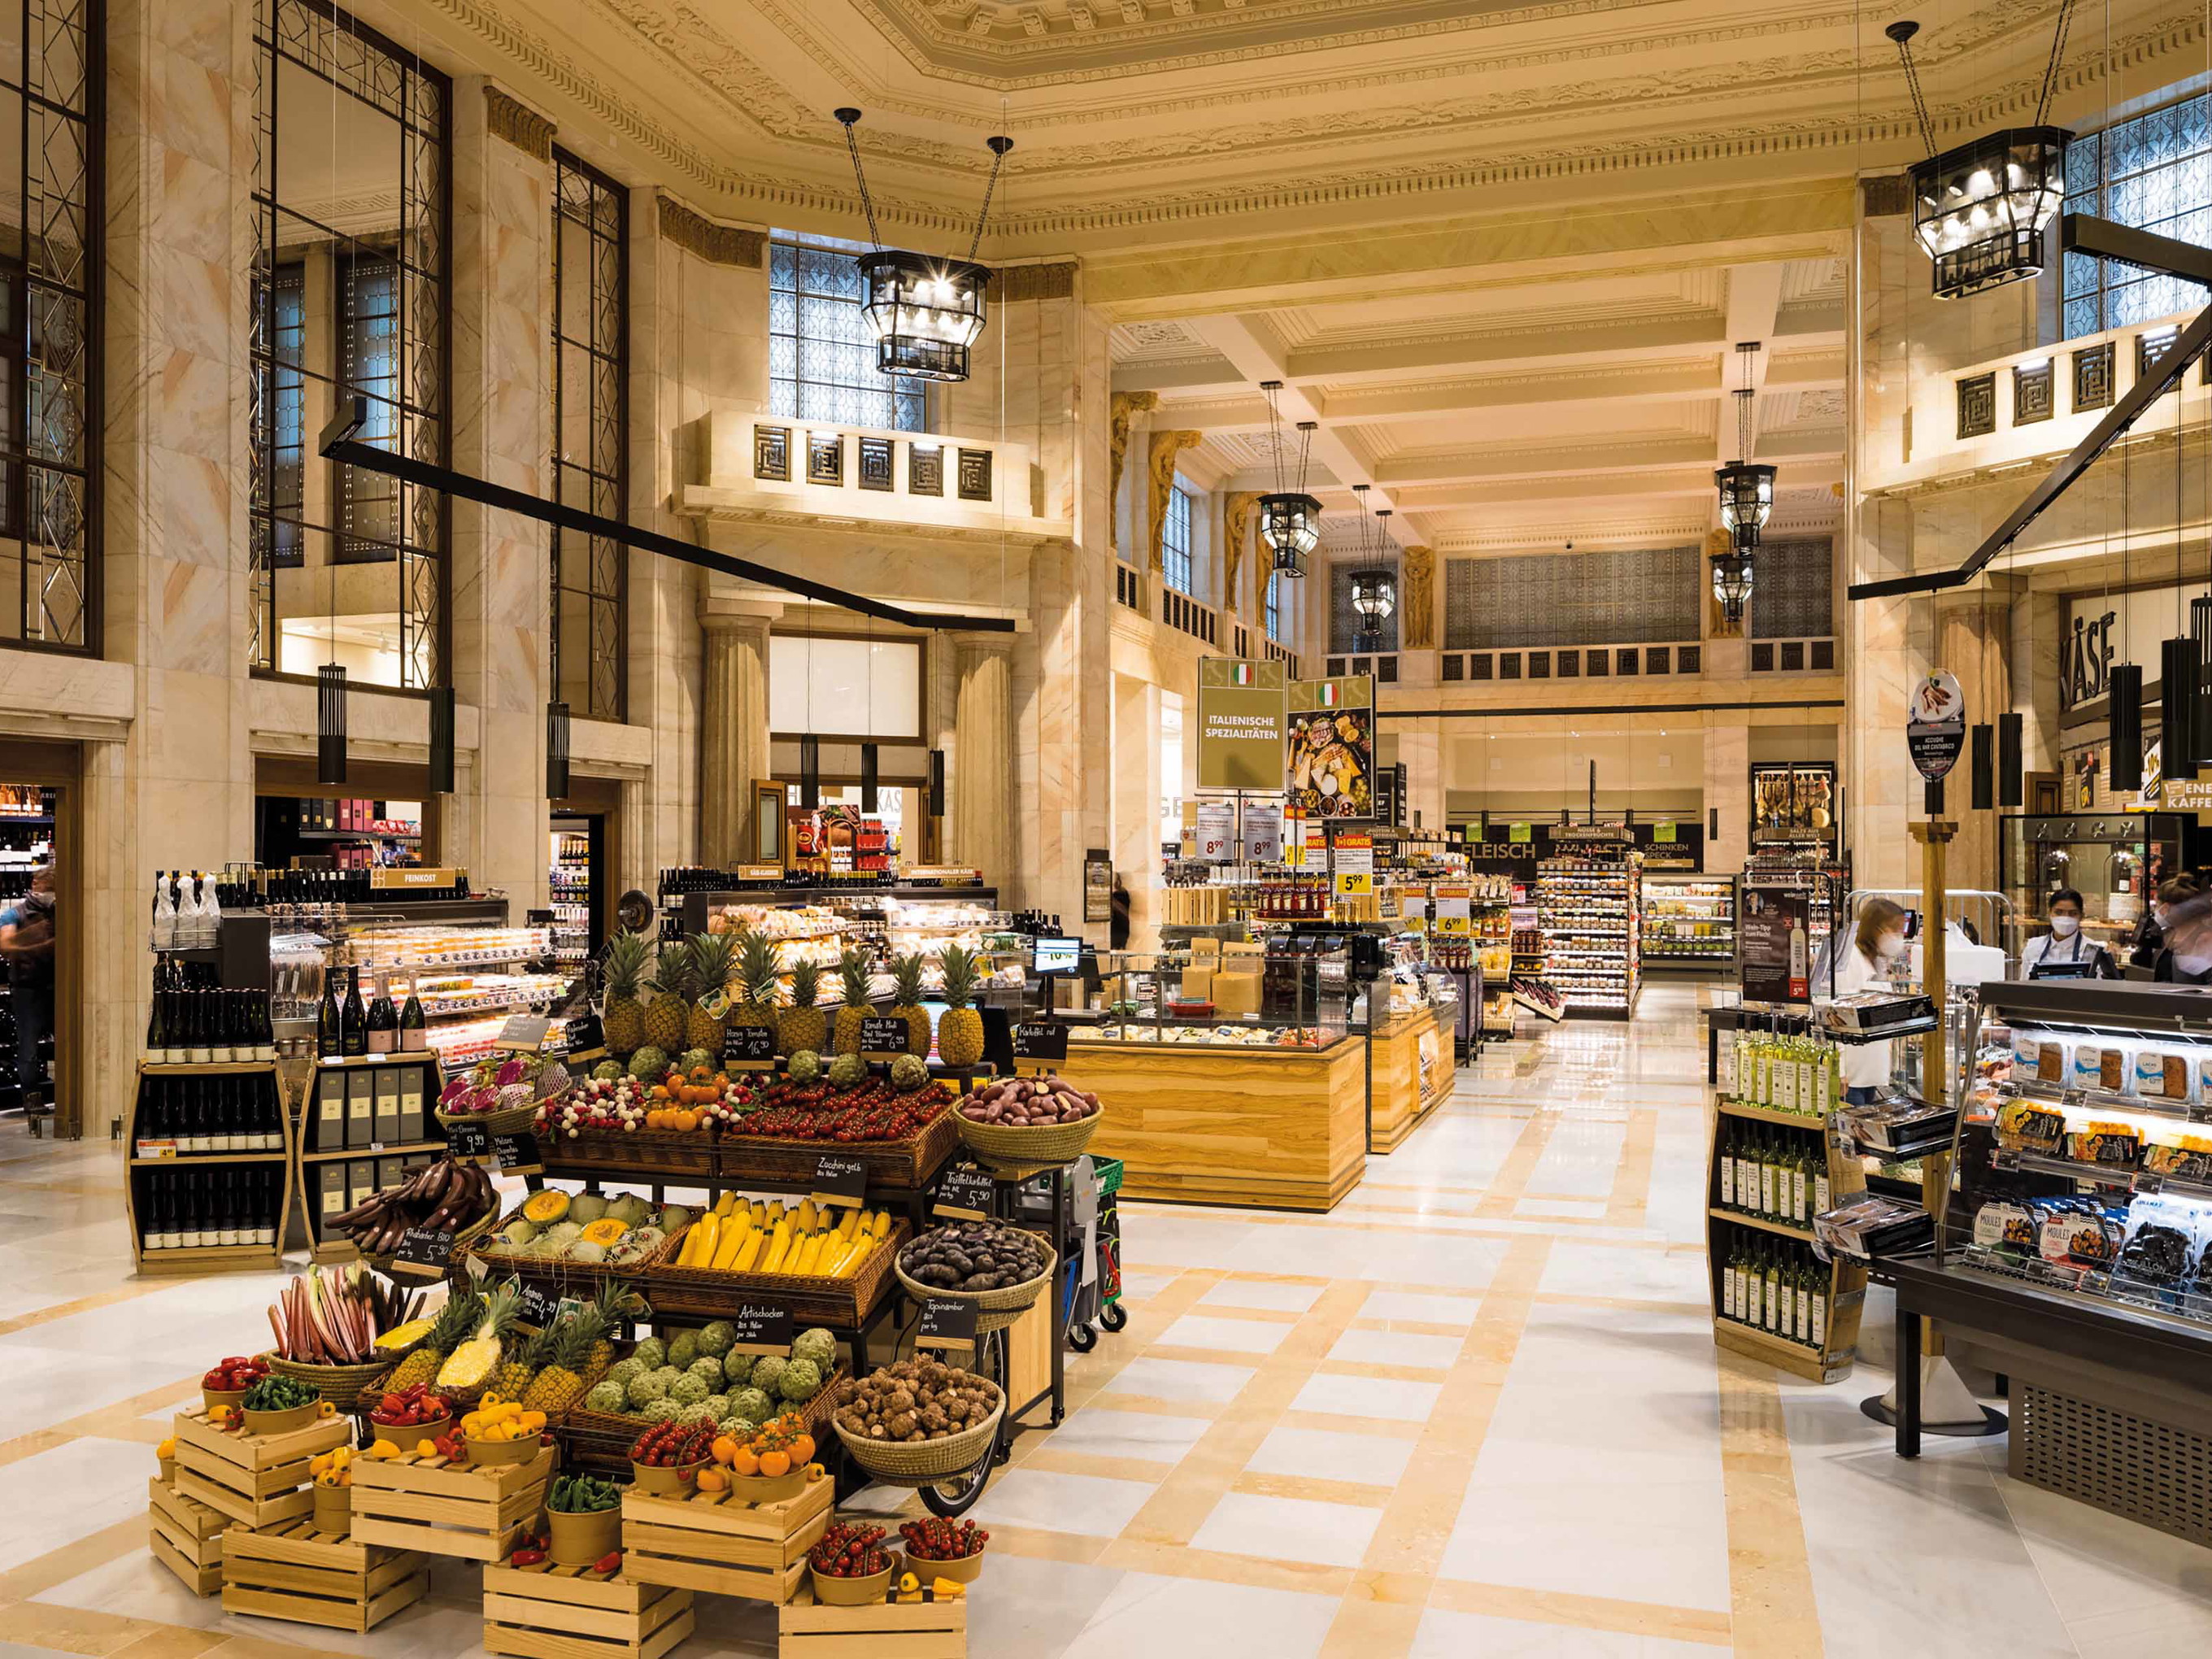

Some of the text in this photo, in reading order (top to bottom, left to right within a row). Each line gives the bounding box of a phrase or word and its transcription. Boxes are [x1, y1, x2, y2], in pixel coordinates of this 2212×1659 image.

[1208, 715, 1274, 725] ITALIENISCHE
[1205, 727, 1278, 739] SPEZIALITÄTEN
[1347, 838, 1371, 847] GRATIS
[1644, 843, 1689, 851] SCHINKEN
[1461, 843, 1536, 860] FLEISCH
[404, 874, 437, 882] FEINKOST
[846, 1162, 861, 1173] gelb
[1979, 1214, 2001, 1228] MOULES
[437, 1231, 451, 1243] BIO
[2046, 1226, 2070, 1241] MOULES
[738, 1304, 784, 1319] Artischocken
[927, 1299, 965, 1313] Topinambur
